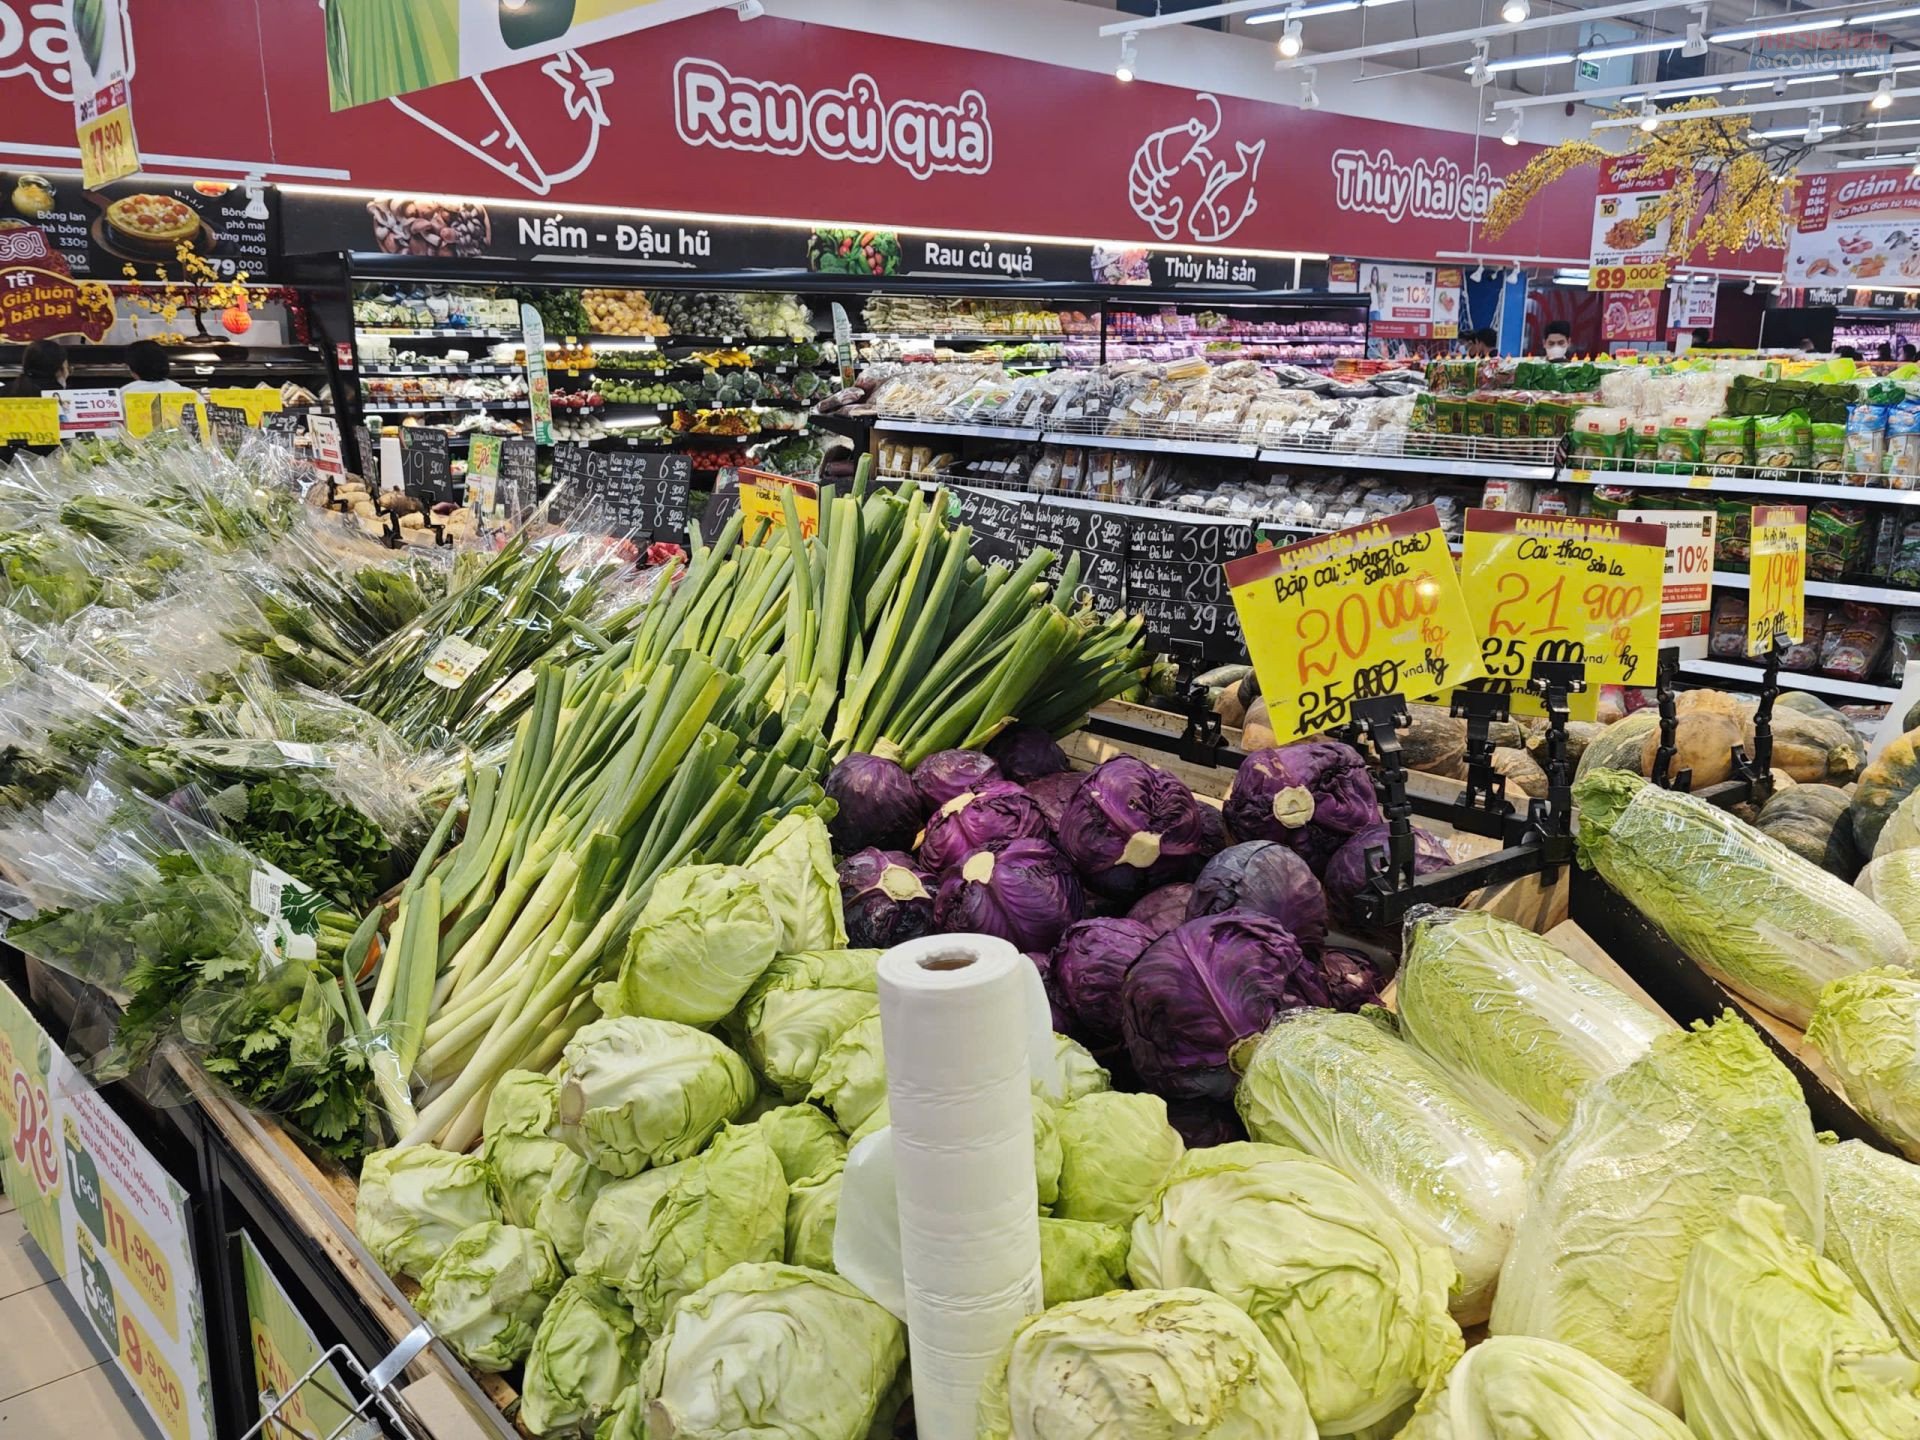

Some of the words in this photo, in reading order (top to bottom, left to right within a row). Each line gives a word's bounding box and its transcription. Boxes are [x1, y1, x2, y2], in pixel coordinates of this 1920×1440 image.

[681, 66, 802, 148] Rau
[812, 80, 881, 156] củ
[891, 98, 988, 172] quả
[1334, 156, 1411, 217] Thủy
[1414, 164, 1457, 214] hải
[1811, 175, 1828, 186] Ưu
[1837, 174, 1898, 203] Giảm
[36, 210, 67, 223] Bông
[69, 210, 86, 222] lan
[221, 207, 247, 219] Bông
[1804, 206, 1825, 217] Biệt
[1832, 208, 1850, 219] cho
[58, 225, 87, 238] bông
[226, 219, 246, 231] phô
[247, 221, 266, 231] mai
[517, 213, 588, 249] Nấm
[615, 224, 671, 259] Đậu
[678, 228, 711, 256] hũ
[0, 231, 47, 262] GO!
[59, 238, 88, 249] 330g
[212, 231, 240, 243] trứng
[241, 231, 267, 243] muối
[239, 245, 267, 256] 440g
[924, 241, 964, 267] Rau
[969, 242, 992, 270] củ
[998, 247, 1033, 277] quả
[206, 258, 263, 276] 79.000
[1164, 256, 1202, 283] Thủy
[1205, 254, 1229, 281] hải
[1231, 259, 1257, 283] sản
[1595, 267, 1659, 290] 89.000
[5, 271, 36, 288] TẾT
[3, 291, 32, 308] Giá
[35, 285, 75, 300] luôn
[1406, 286, 1431, 304] 10%
[11, 304, 41, 324] bất
[44, 301, 72, 318] bại
[90, 399, 118, 409] 10%
[1514, 517, 1586, 537] KHUYẾN
[1588, 521, 1621, 540] MÃI
[1279, 532, 1356, 568] KHUYẾN
[1356, 522, 1393, 543] MÃI
[1677, 545, 1709, 574] 10%
[1274, 566, 1308, 607] Bắp
[1618, 644, 1639, 682] kg
[13, 1072, 59, 1194] Rẻ
